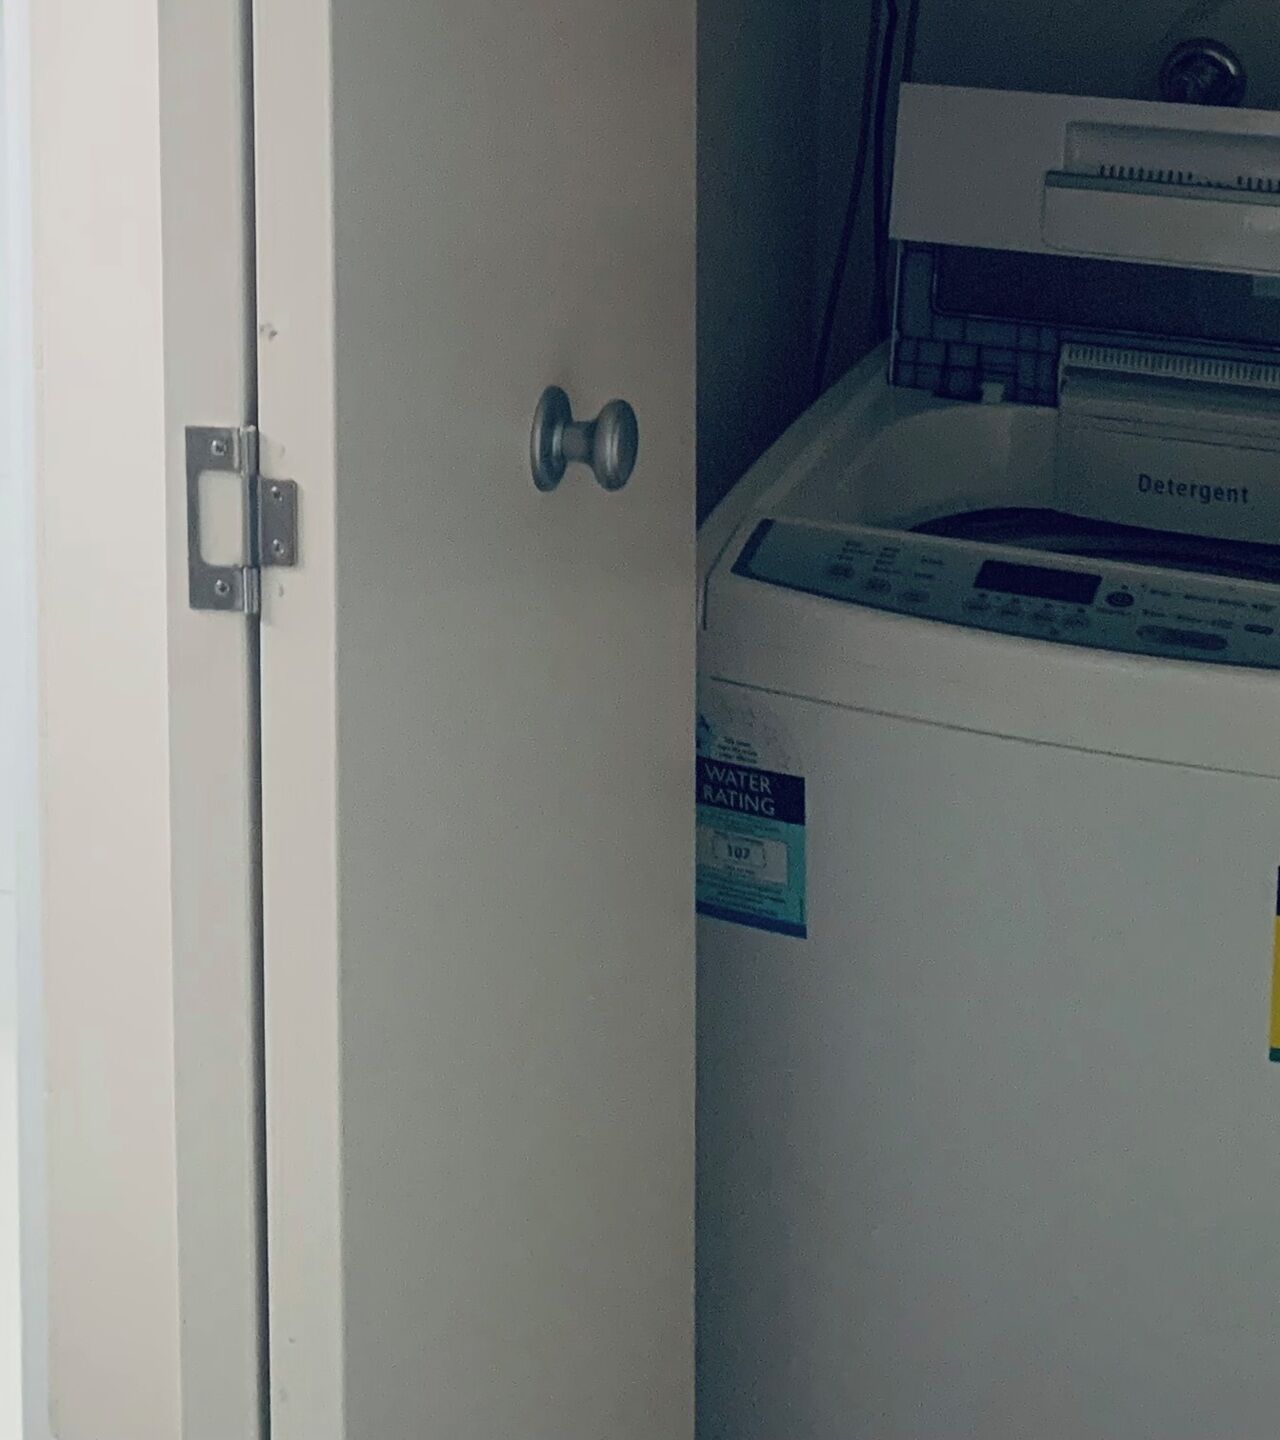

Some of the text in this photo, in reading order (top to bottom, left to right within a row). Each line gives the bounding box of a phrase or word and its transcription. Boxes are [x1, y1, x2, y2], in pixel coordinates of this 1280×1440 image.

[1138, 474, 1249, 504] Detergent
[704, 763, 772, 795] WATER
[703, 784, 775, 816] RATING
